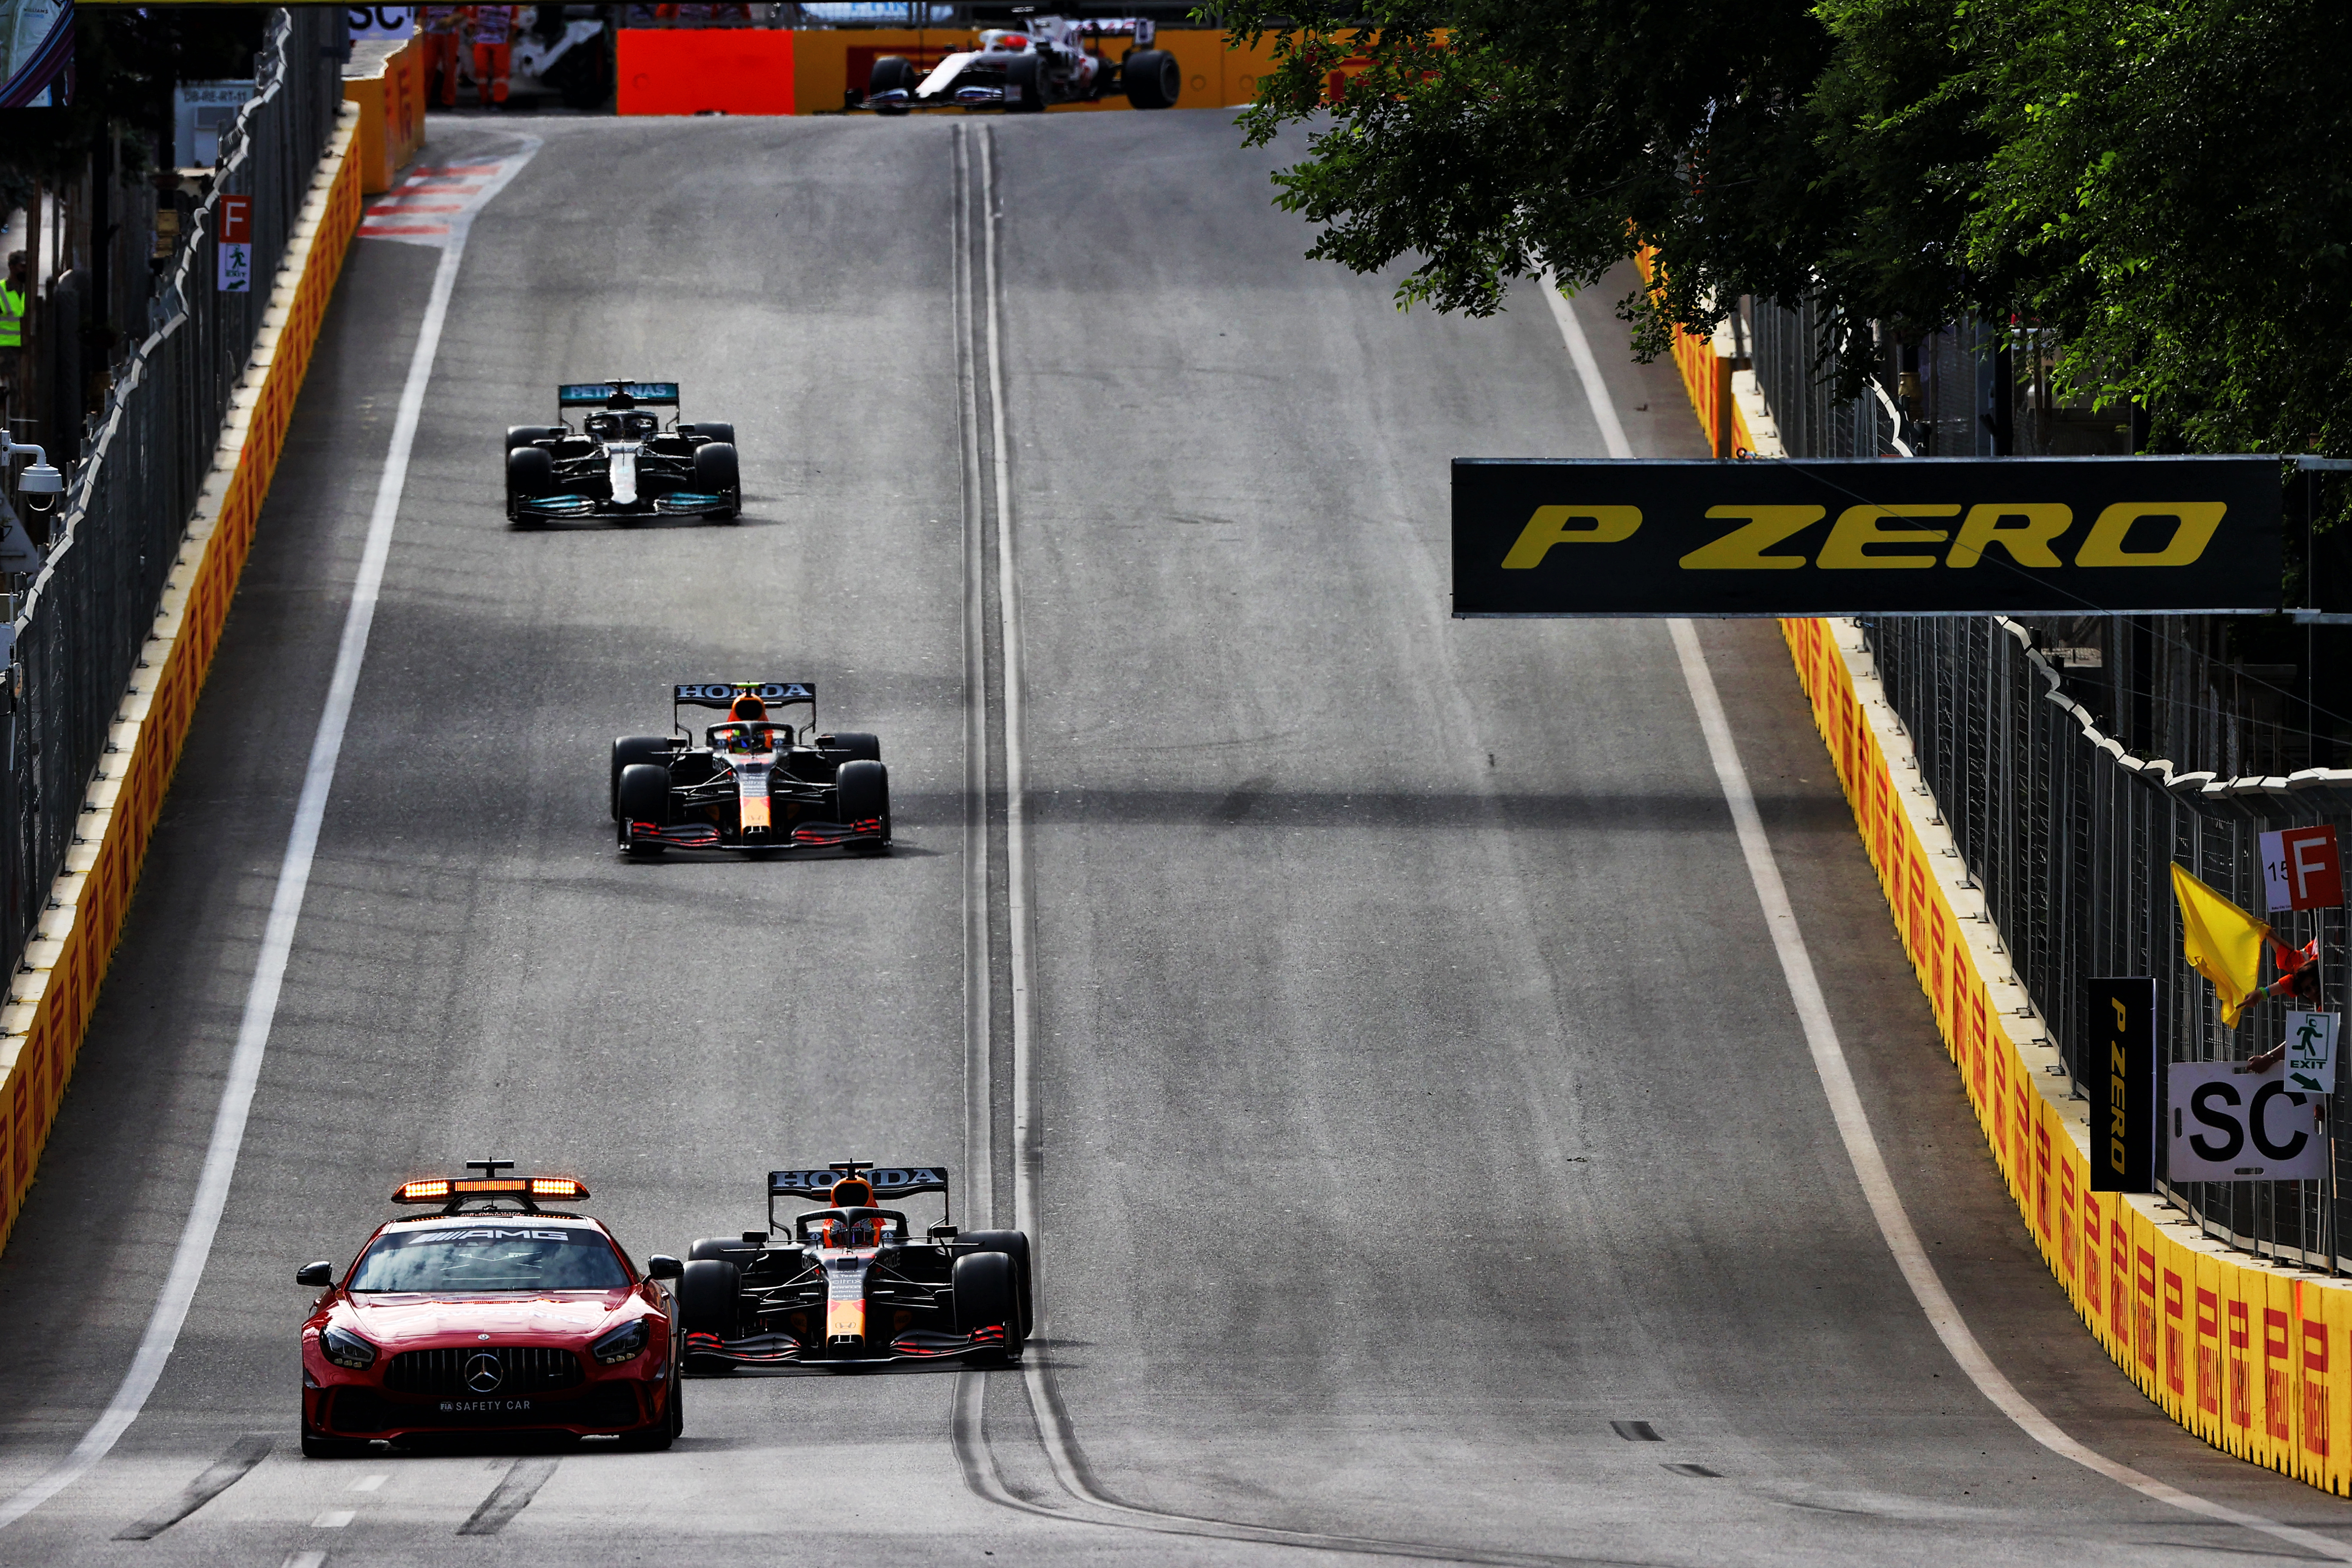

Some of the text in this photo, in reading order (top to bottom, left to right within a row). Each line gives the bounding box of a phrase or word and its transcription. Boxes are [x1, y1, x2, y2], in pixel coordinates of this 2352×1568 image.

[225, 202, 247, 237] F
[1501, 502, 2227, 569] P ZERO
[2268, 861, 2288, 882] 15
[2293, 837, 2327, 899] F
[2290, 1060, 2326, 1069] EXIT
[2112, 998, 2125, 1174] P ZERO
[2190, 1080, 2308, 1162] SC
[458, 1230, 569, 1241] AMG
[456, 1401, 501, 1411] SAFETY
[506, 1400, 530, 1410] CAR
